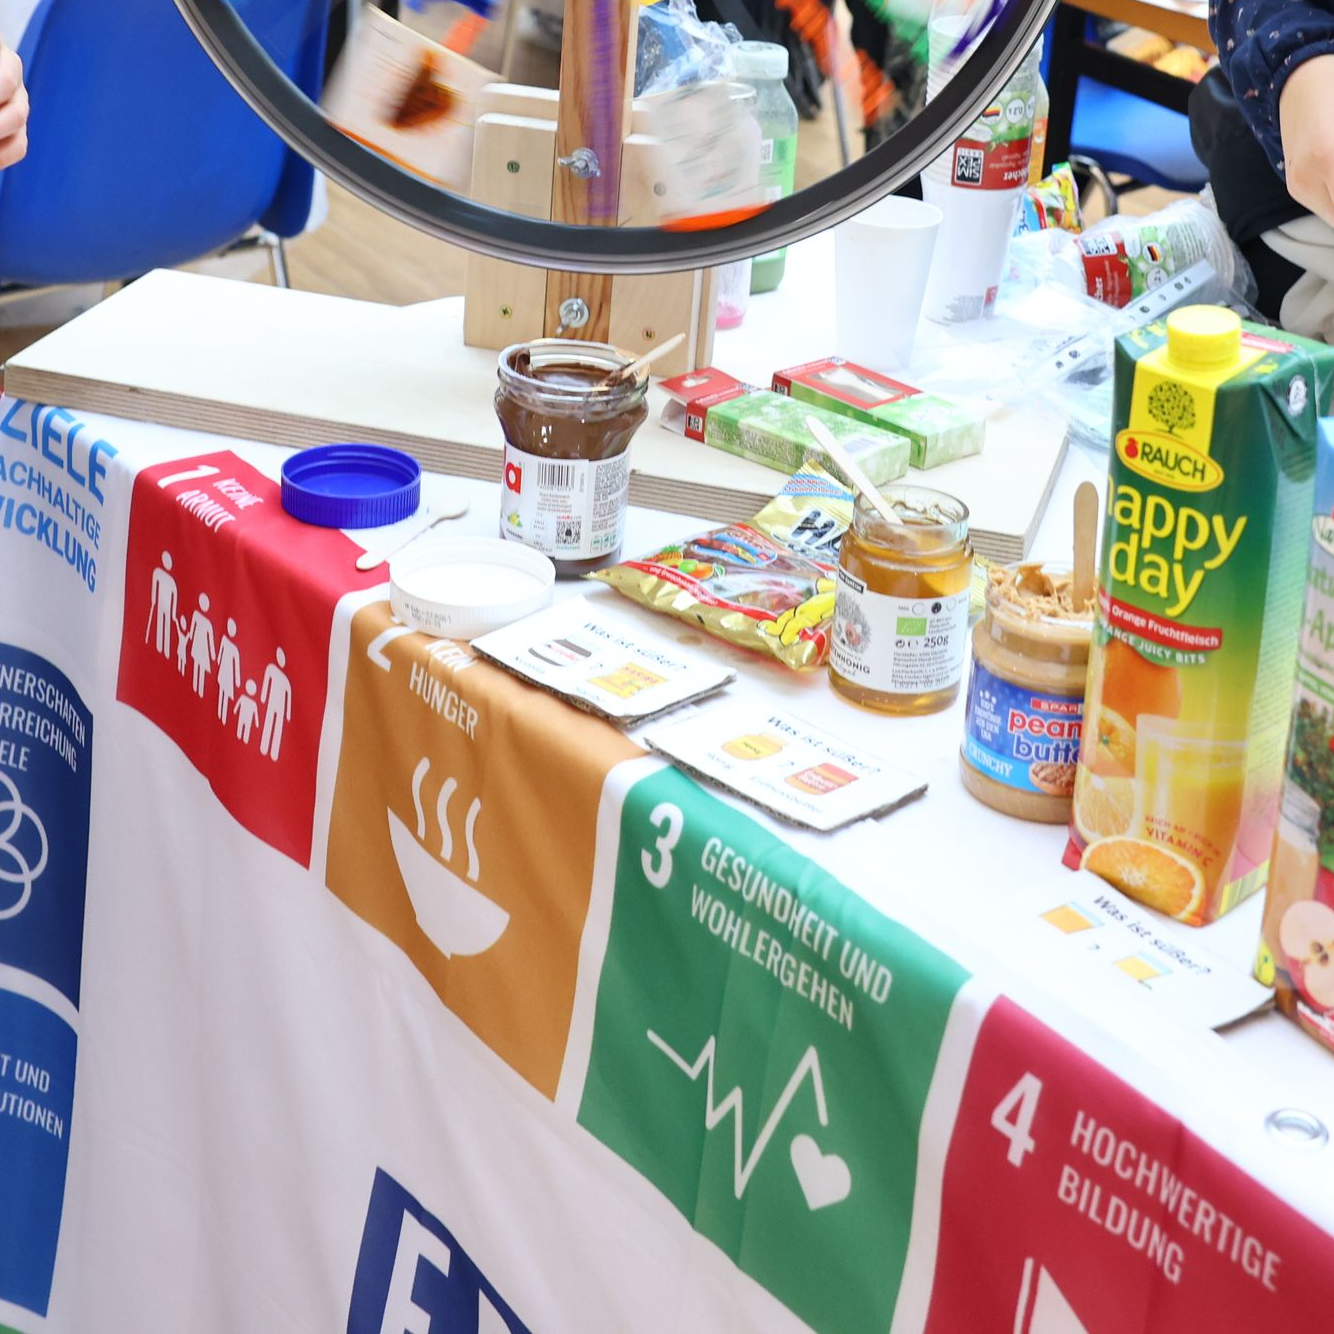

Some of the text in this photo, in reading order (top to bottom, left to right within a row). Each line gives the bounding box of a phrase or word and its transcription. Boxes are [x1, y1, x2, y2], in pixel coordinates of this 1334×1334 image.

[0, 398, 120, 507] ZIELE
[1140, 441, 1207, 483] RAUCH
[175, 489, 236, 533] ARMUT
[212, 477, 264, 511] KEINE
[1109, 533, 1205, 617] day
[1111, 604, 1220, 647] Orange Fruchtfleisch
[1175, 651, 1207, 665] BITS
[409, 661, 479, 742] HUNGER
[767, 715, 800, 737] Was
[802, 735, 823, 748] ist
[969, 742, 1014, 778] CRUNCHY
[640, 802, 684, 889] 3
[699, 836, 894, 1004] GESUNDHEIT UND
[1093, 895, 1128, 922] Was
[1127, 921, 1152, 939] ist
[690, 884, 855, 1032] WOHLERGEHEN
[15, 1058, 51, 1094] UND
[990, 1071, 1044, 1168] 4
[1056, 1163, 1188, 1286] BILDUNG
[1069, 1109, 1284, 1294] HOCHWERTIGE
